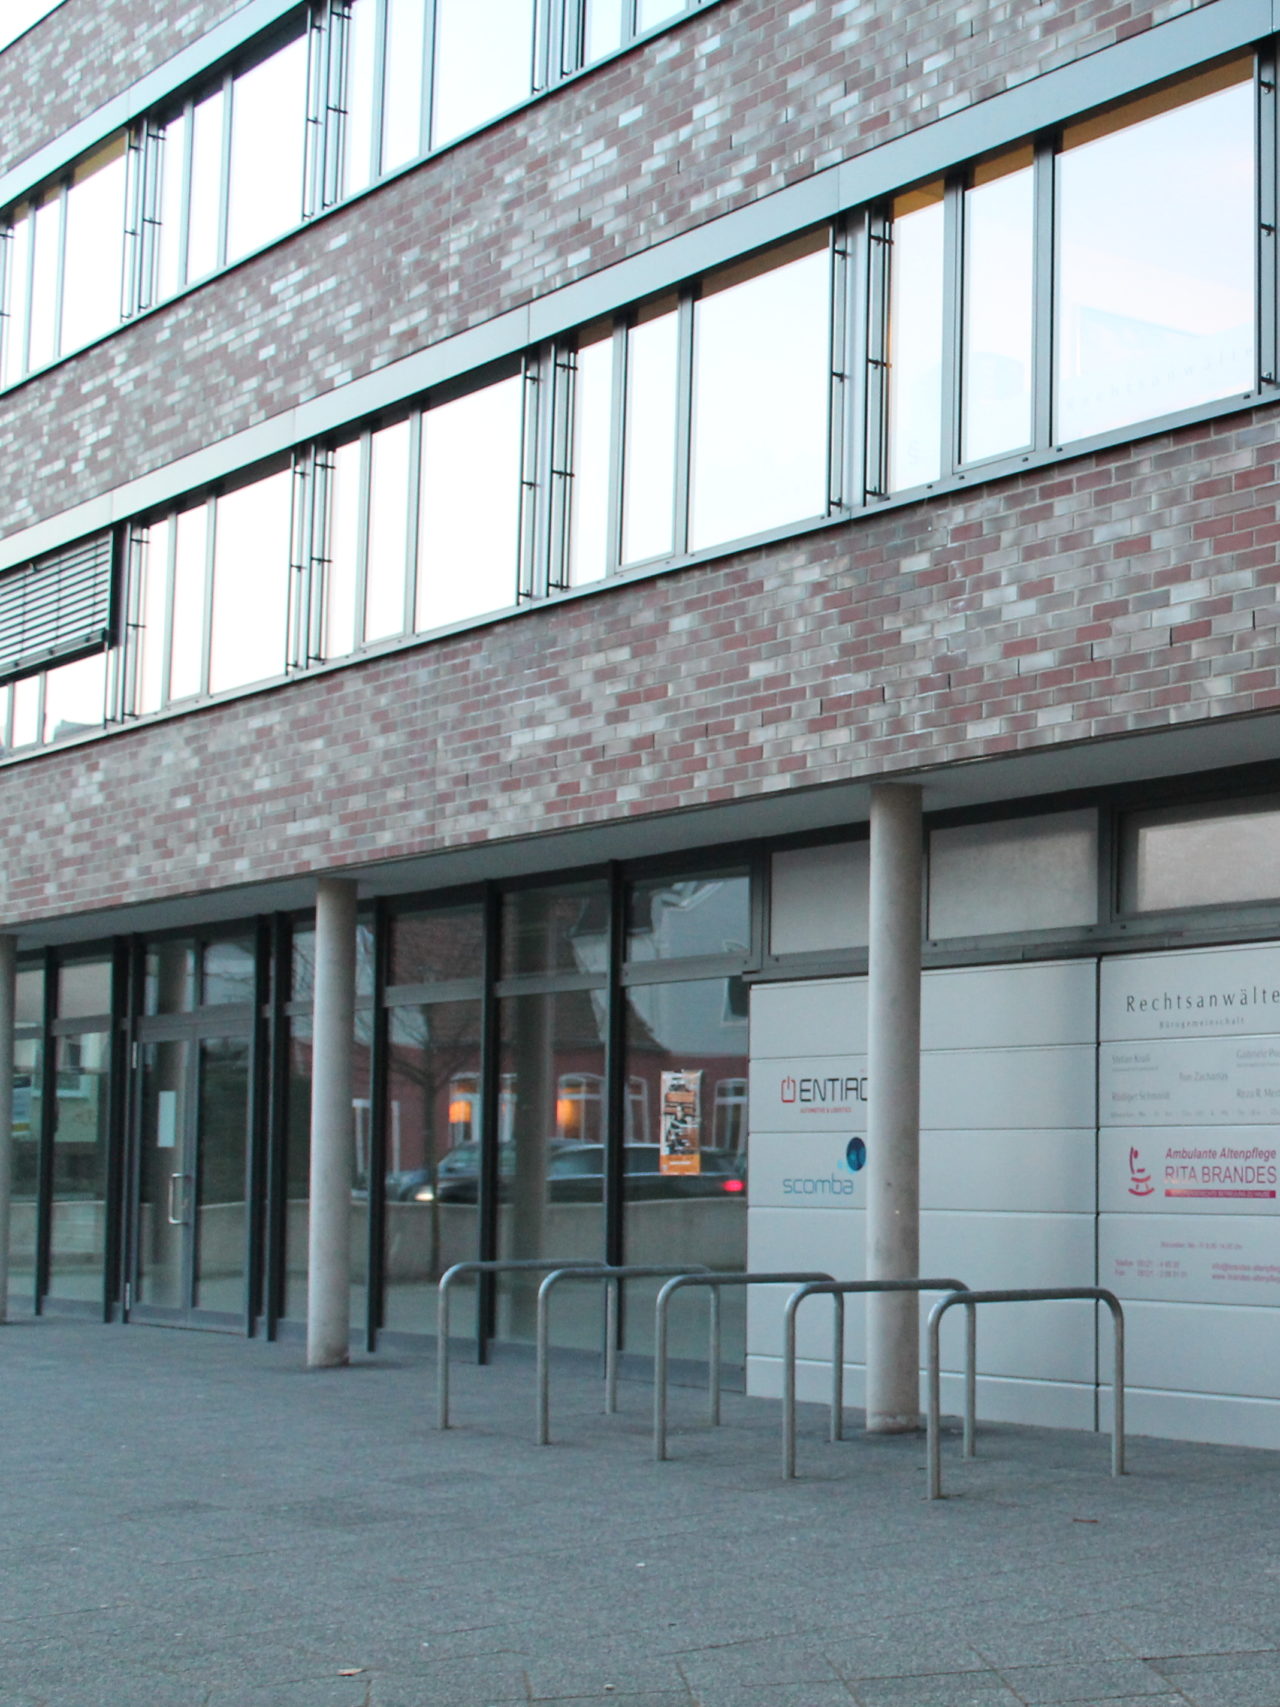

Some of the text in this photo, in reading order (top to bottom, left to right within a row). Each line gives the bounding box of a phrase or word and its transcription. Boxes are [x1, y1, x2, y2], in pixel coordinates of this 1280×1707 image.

[1126, 986, 1280, 1013] Rechtsanwälte
[1165, 1147, 1277, 1162] Ambulante Altenpflege
[782, 1172, 854, 1195] scomba
[1165, 1166, 1277, 1184] RITA BRANDES
